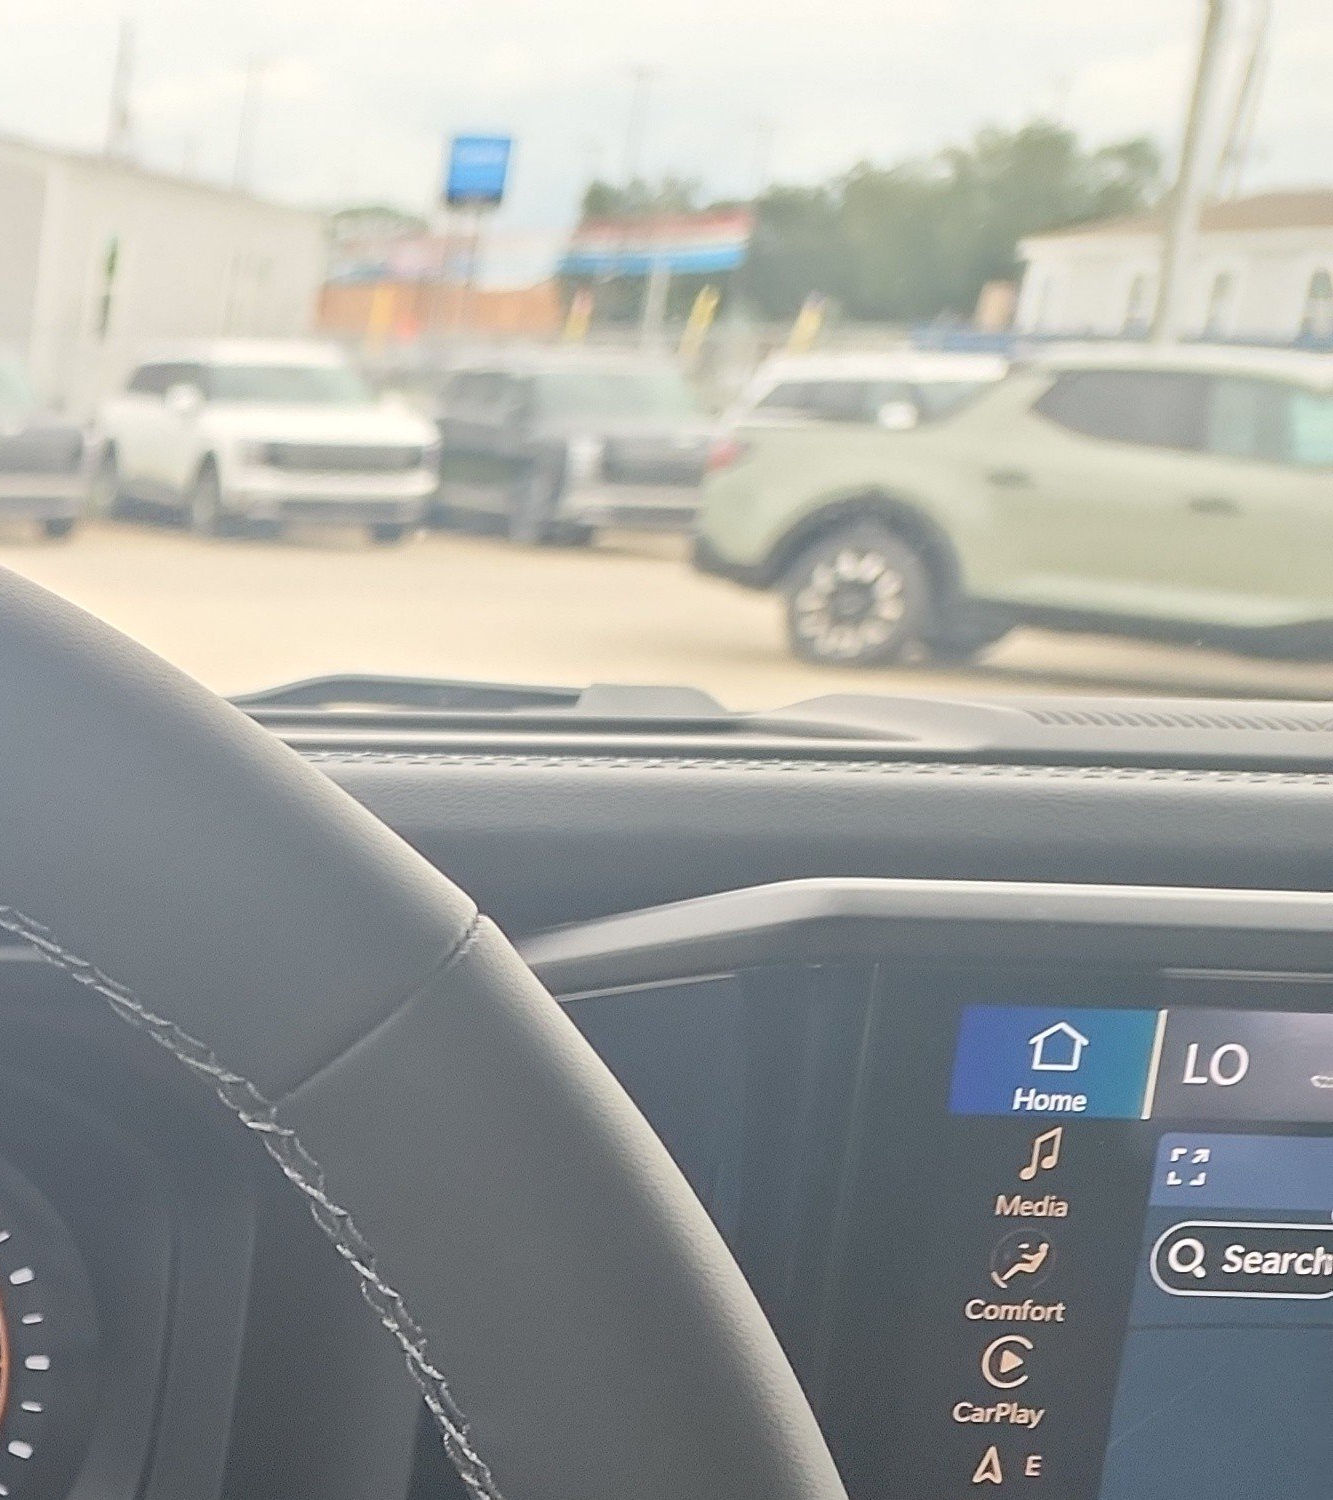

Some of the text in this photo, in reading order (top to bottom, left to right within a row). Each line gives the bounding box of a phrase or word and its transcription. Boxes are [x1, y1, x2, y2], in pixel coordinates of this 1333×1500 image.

[1182, 1042, 1250, 1086] LO
[1011, 1087, 1088, 1113] Home
[994, 1194, 1069, 1218] Media
[1221, 1244, 1333, 1277] Search
[964, 1299, 1067, 1324] Comfort
[952, 1401, 1045, 1429] CarPlay
[1024, 1455, 1043, 1478] E
